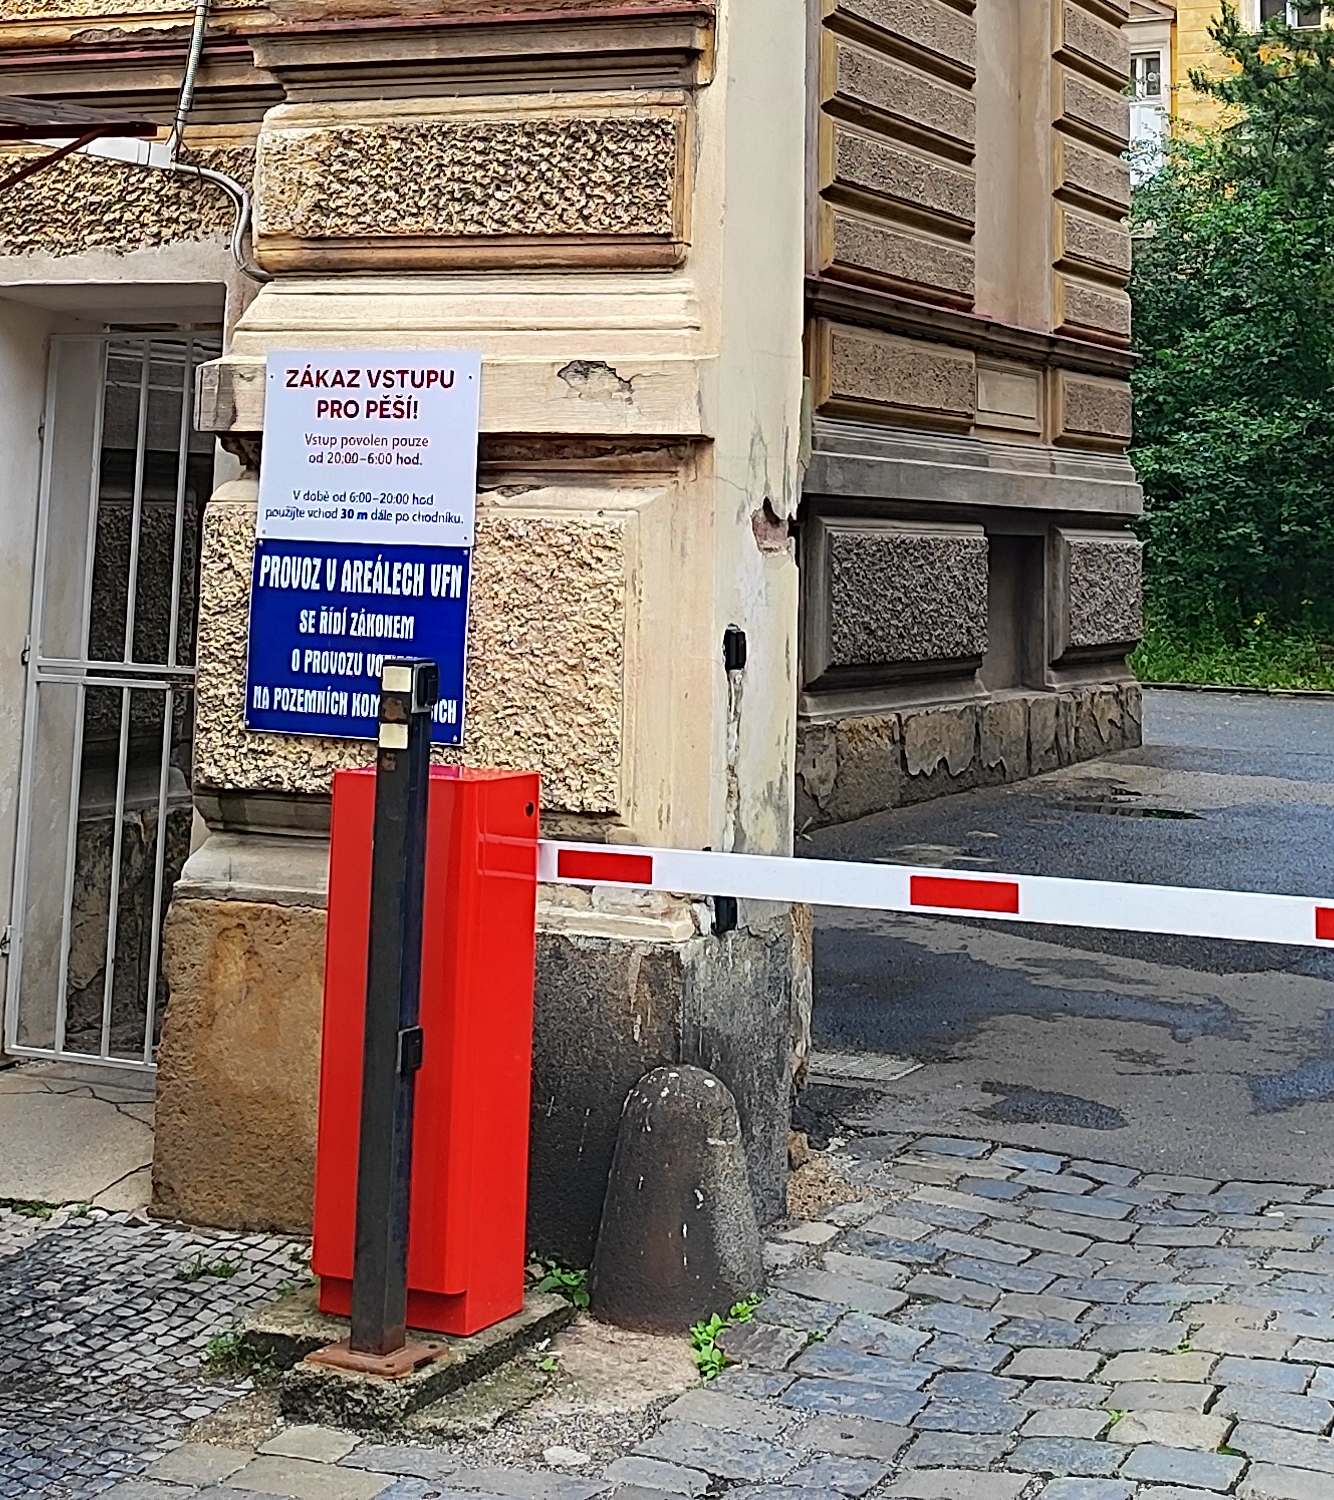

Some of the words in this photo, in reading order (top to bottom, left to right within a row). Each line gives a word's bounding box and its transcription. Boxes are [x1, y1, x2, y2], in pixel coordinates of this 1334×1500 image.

[285, 364, 361, 388] ZÁKAZ
[367, 369, 455, 389] VSTUPU
[317, 400, 359, 419] PRO
[366, 394, 419, 419] PĚŠÍ!
[305, 433, 337, 449] Vstup
[340, 433, 388, 449] povolen
[392, 437, 429, 450] pouze
[308, 452, 324, 464] od
[396, 453, 423, 466] hod.
[292, 489, 301, 501] V
[303, 490, 329, 502] době
[332, 491, 347, 503] od
[307, 507, 338, 519] vchod
[340, 508, 355, 520] 30
[357, 510, 368, 520] m
[370, 508, 393, 522] dále
[395, 512, 410, 524] po
[412, 510, 464, 525] chodníku.
[259, 555, 322, 590] PROVOZ
[327, 558, 337, 591] V
[341, 554, 425, 597] AREÁLECH
[430, 563, 463, 598] VFN
[299, 609, 316, 633] SE
[319, 605, 348, 636] ŘÍDÍ
[349, 607, 415, 640] ZÁKONEM
[291, 648, 300, 672] O
[304, 649, 363, 677] PROVOZU
[253, 685, 270, 710] NA
[273, 686, 348, 717] POZEMNÍCH
